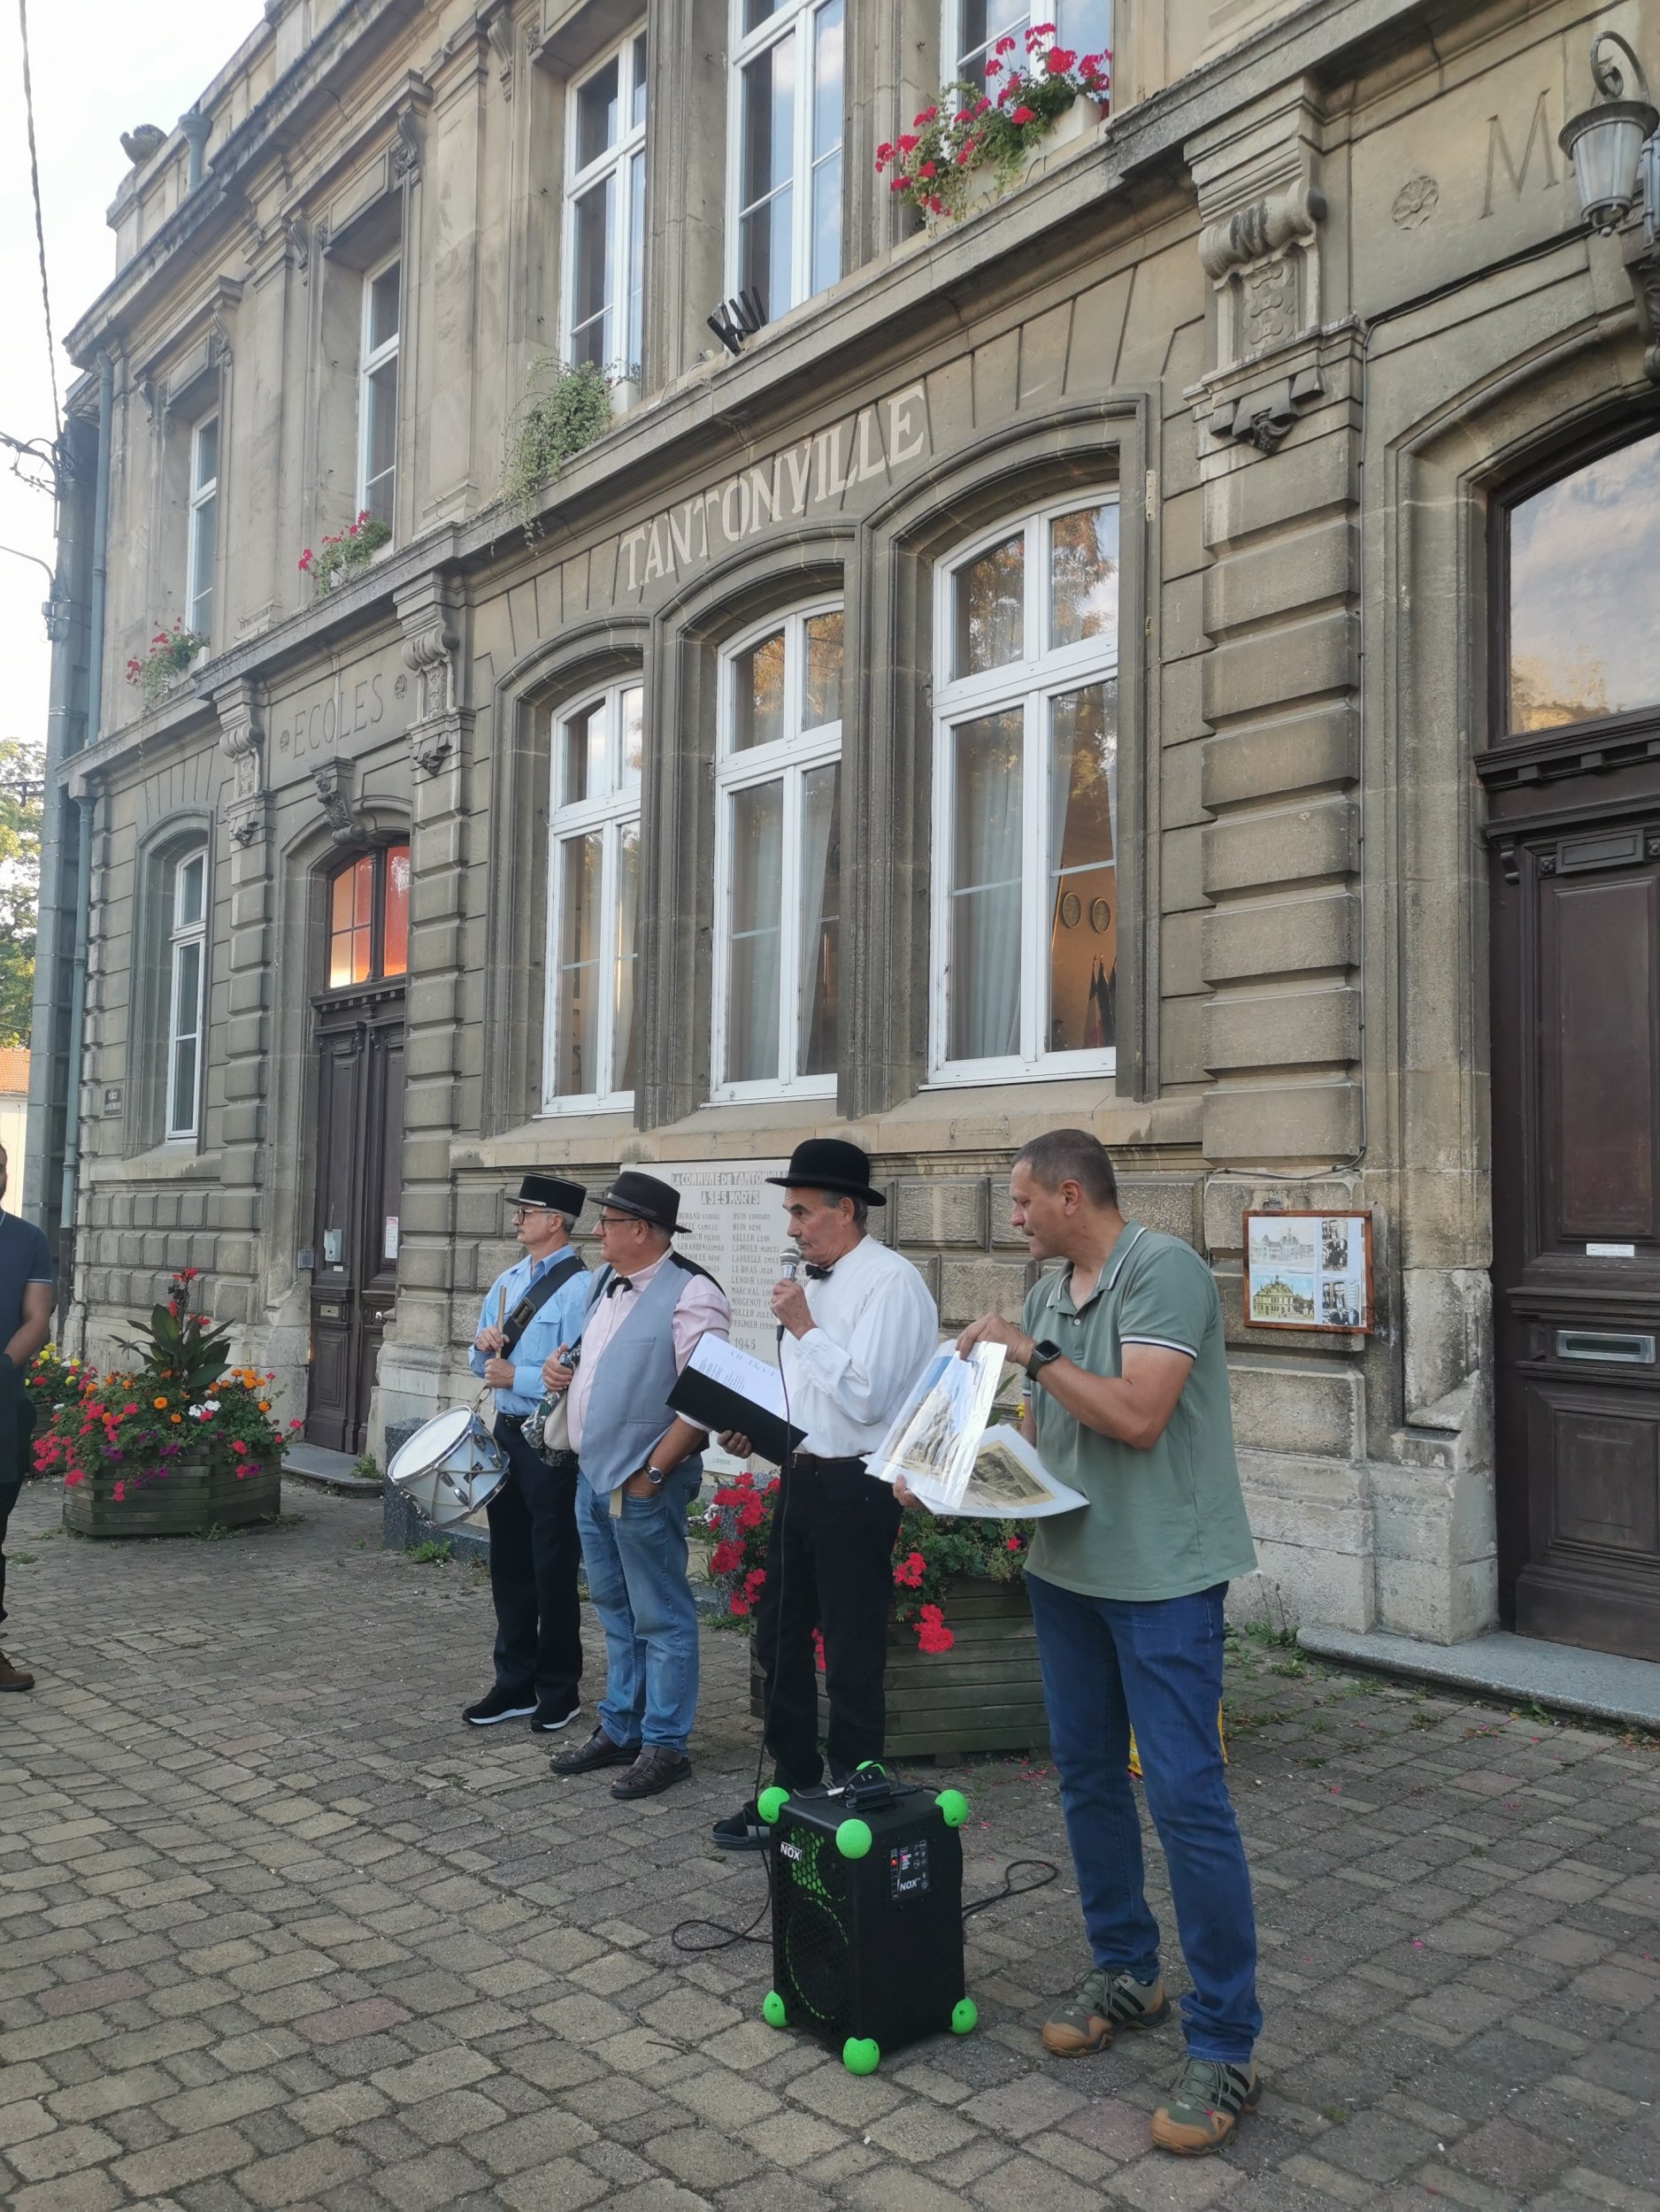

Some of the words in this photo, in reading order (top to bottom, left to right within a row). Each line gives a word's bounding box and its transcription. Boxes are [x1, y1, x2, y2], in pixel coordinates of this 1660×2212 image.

[620, 384, 925, 591] TANTONVILLE
[293, 672, 384, 758] ECOLES
[672, 1173, 680, 1186] LA
[680, 1172, 719, 1186] COMMUNE
[720, 1172, 733, 1186] DE
[708, 1191, 727, 1204] SES
[728, 1190, 760, 1204] MORTS
[732, 1276, 755, 1285] LENOIR
[732, 1286, 760, 1296] MARCHAL
[732, 1297, 762, 1308] MOUGENOT
[735, 1337, 756, 1350] 1945
[780, 1843, 800, 1861] NOX
[900, 1878, 918, 1892] NOX
